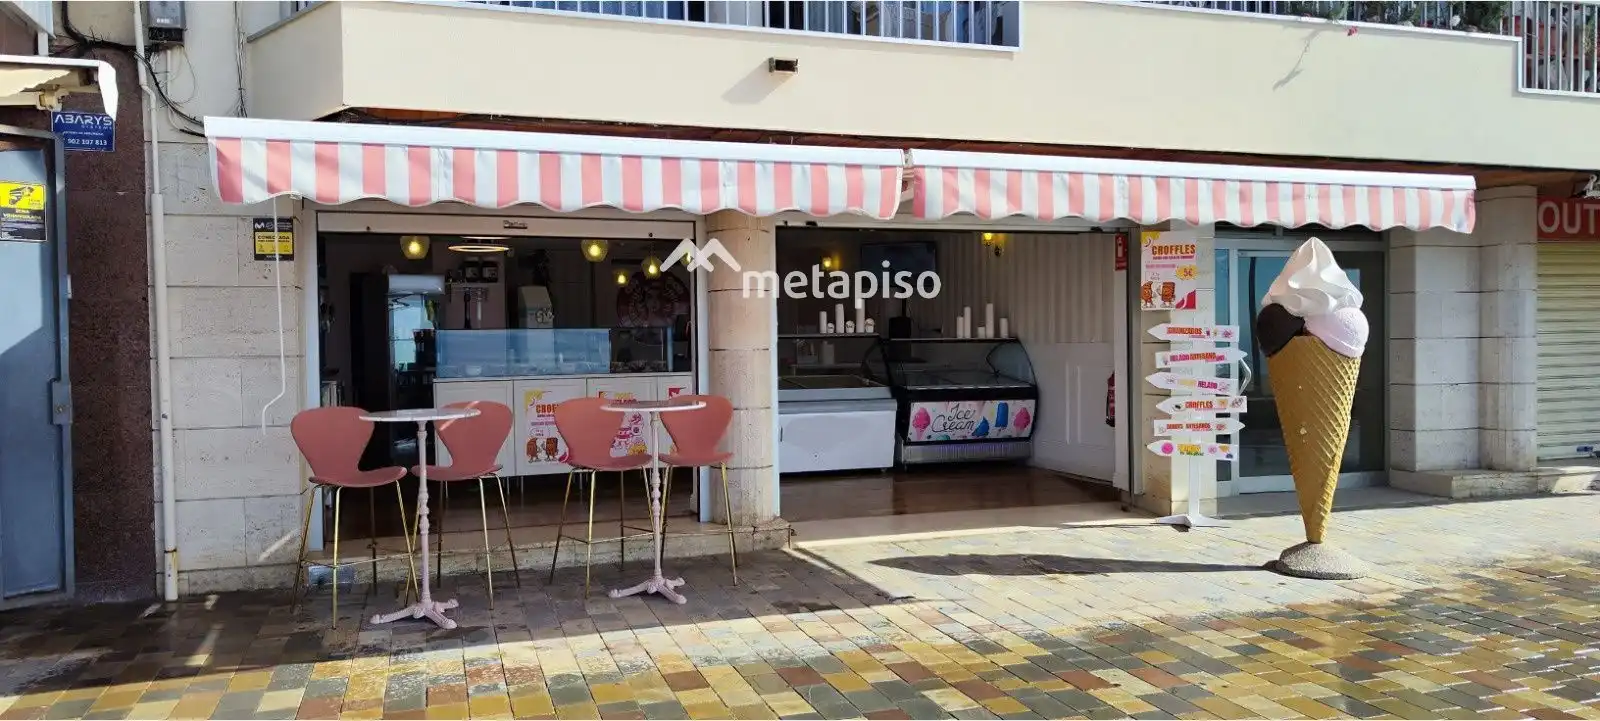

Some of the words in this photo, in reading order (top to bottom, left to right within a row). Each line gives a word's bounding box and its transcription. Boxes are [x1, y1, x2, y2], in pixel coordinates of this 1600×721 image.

[55, 114, 112, 125] ABARYS
[1152, 244, 1196, 255] CROFFLES
[1184, 268, 1193, 277] 5€
[1185, 400, 1213, 409] CROFFLES
[947, 403, 976, 421] Ice
[931, 414, 976, 433] Cream
